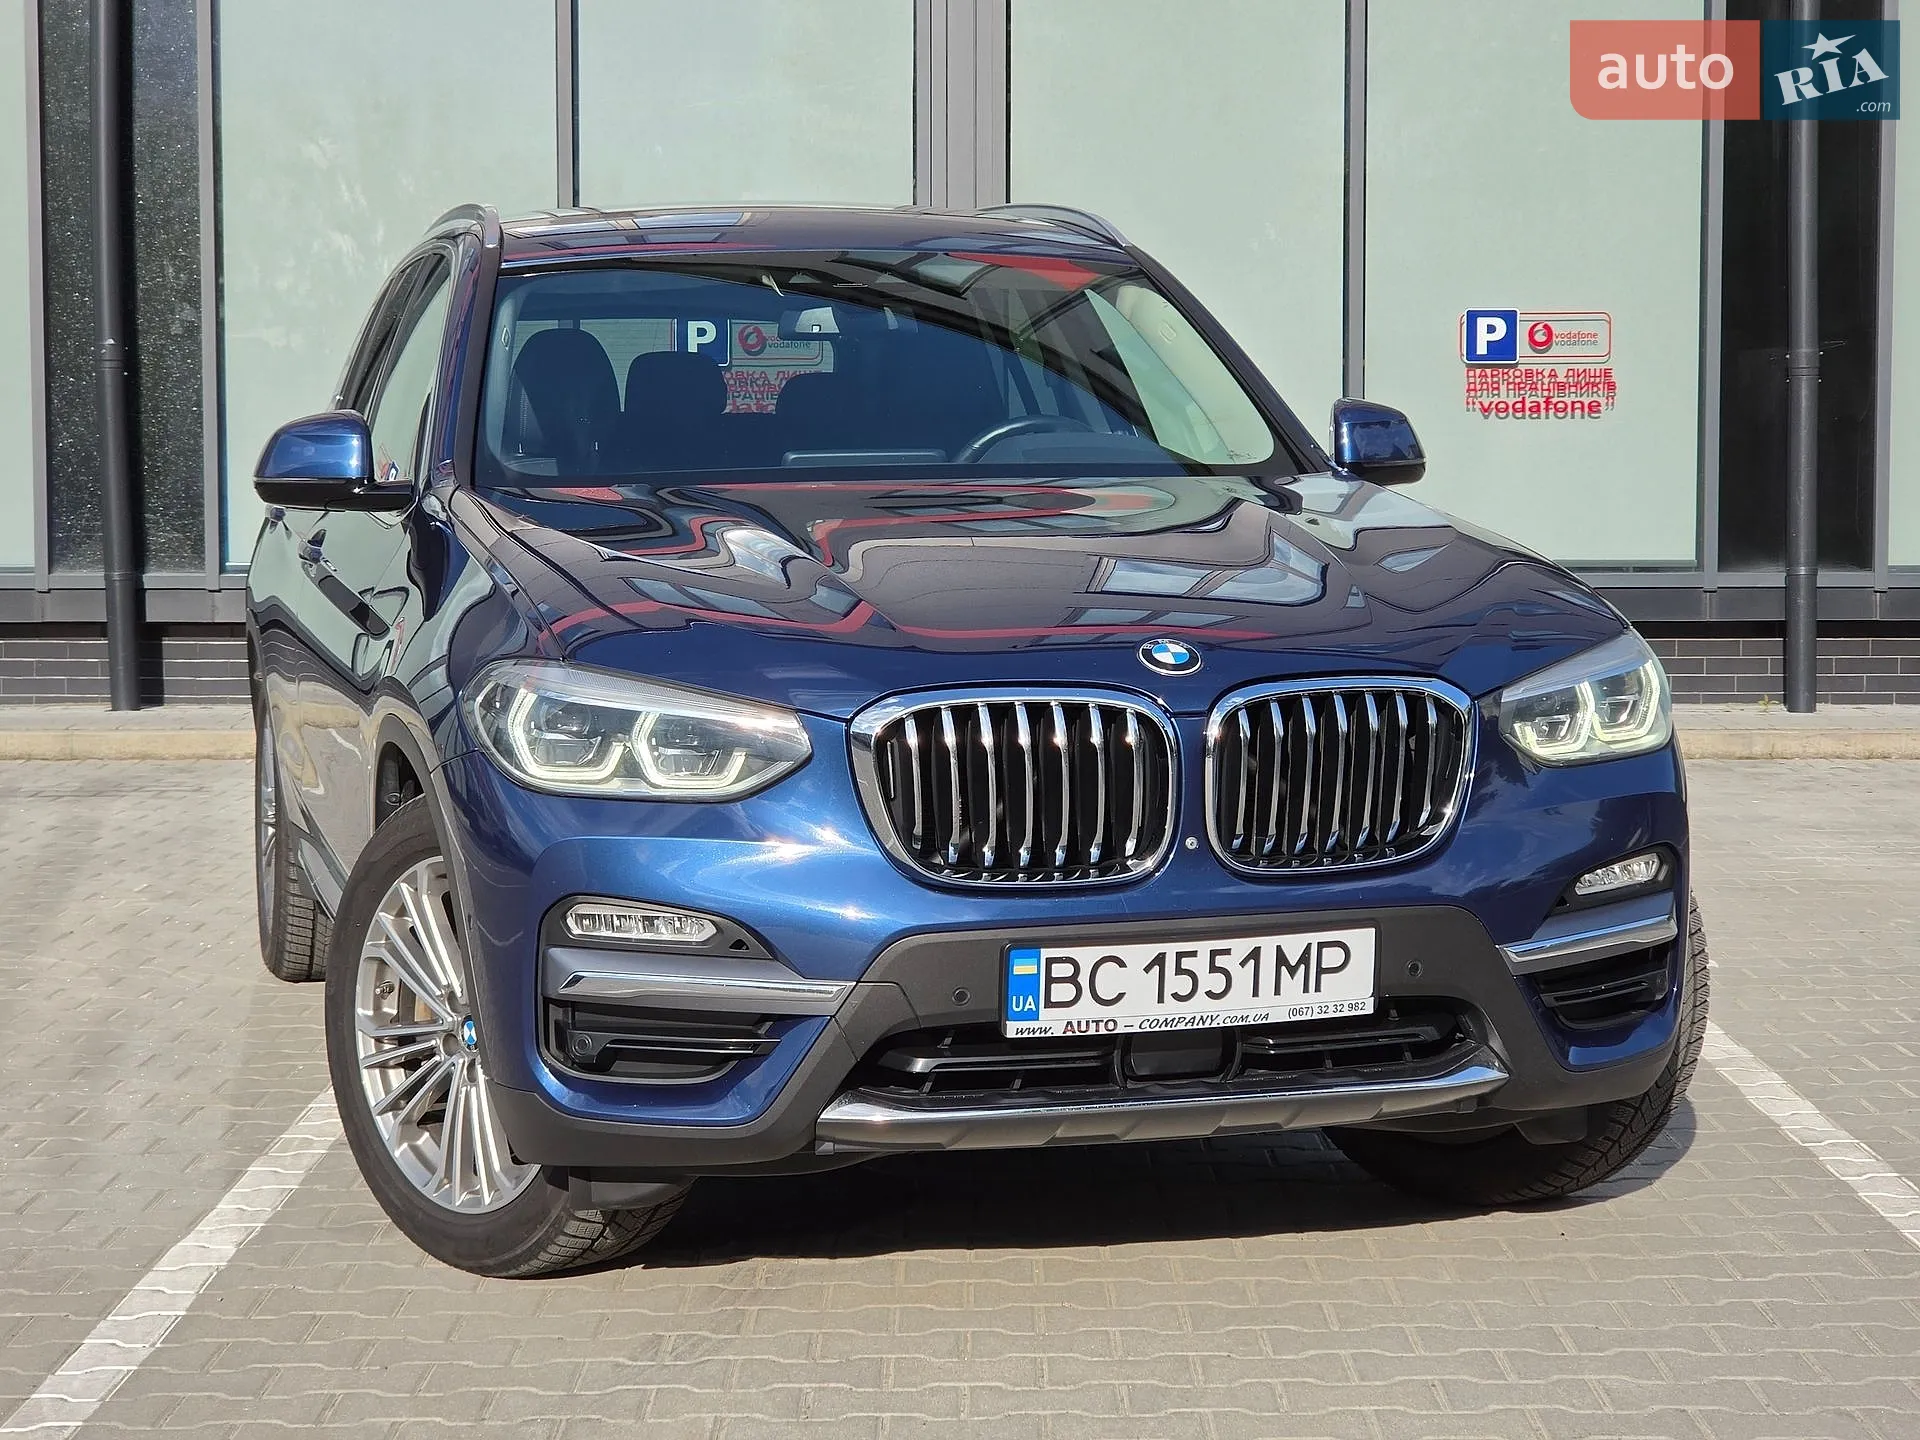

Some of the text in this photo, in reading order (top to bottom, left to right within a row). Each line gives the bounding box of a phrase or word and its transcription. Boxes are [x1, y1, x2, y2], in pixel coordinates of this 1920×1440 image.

[687, 320, 717, 353] P
[1476, 316, 1507, 355] P
[1555, 331, 1599, 341] vodafone
[1466, 367, 1614, 379] ПАРКОВКА ЛИШЕ
[1043, 955, 1127, 1009] BC
[1011, 995, 1036, 1013] UA
[1287, 1001, 1367, 1019] (067) 32 32 982
[1062, 1018, 1118, 1035] AUTO
